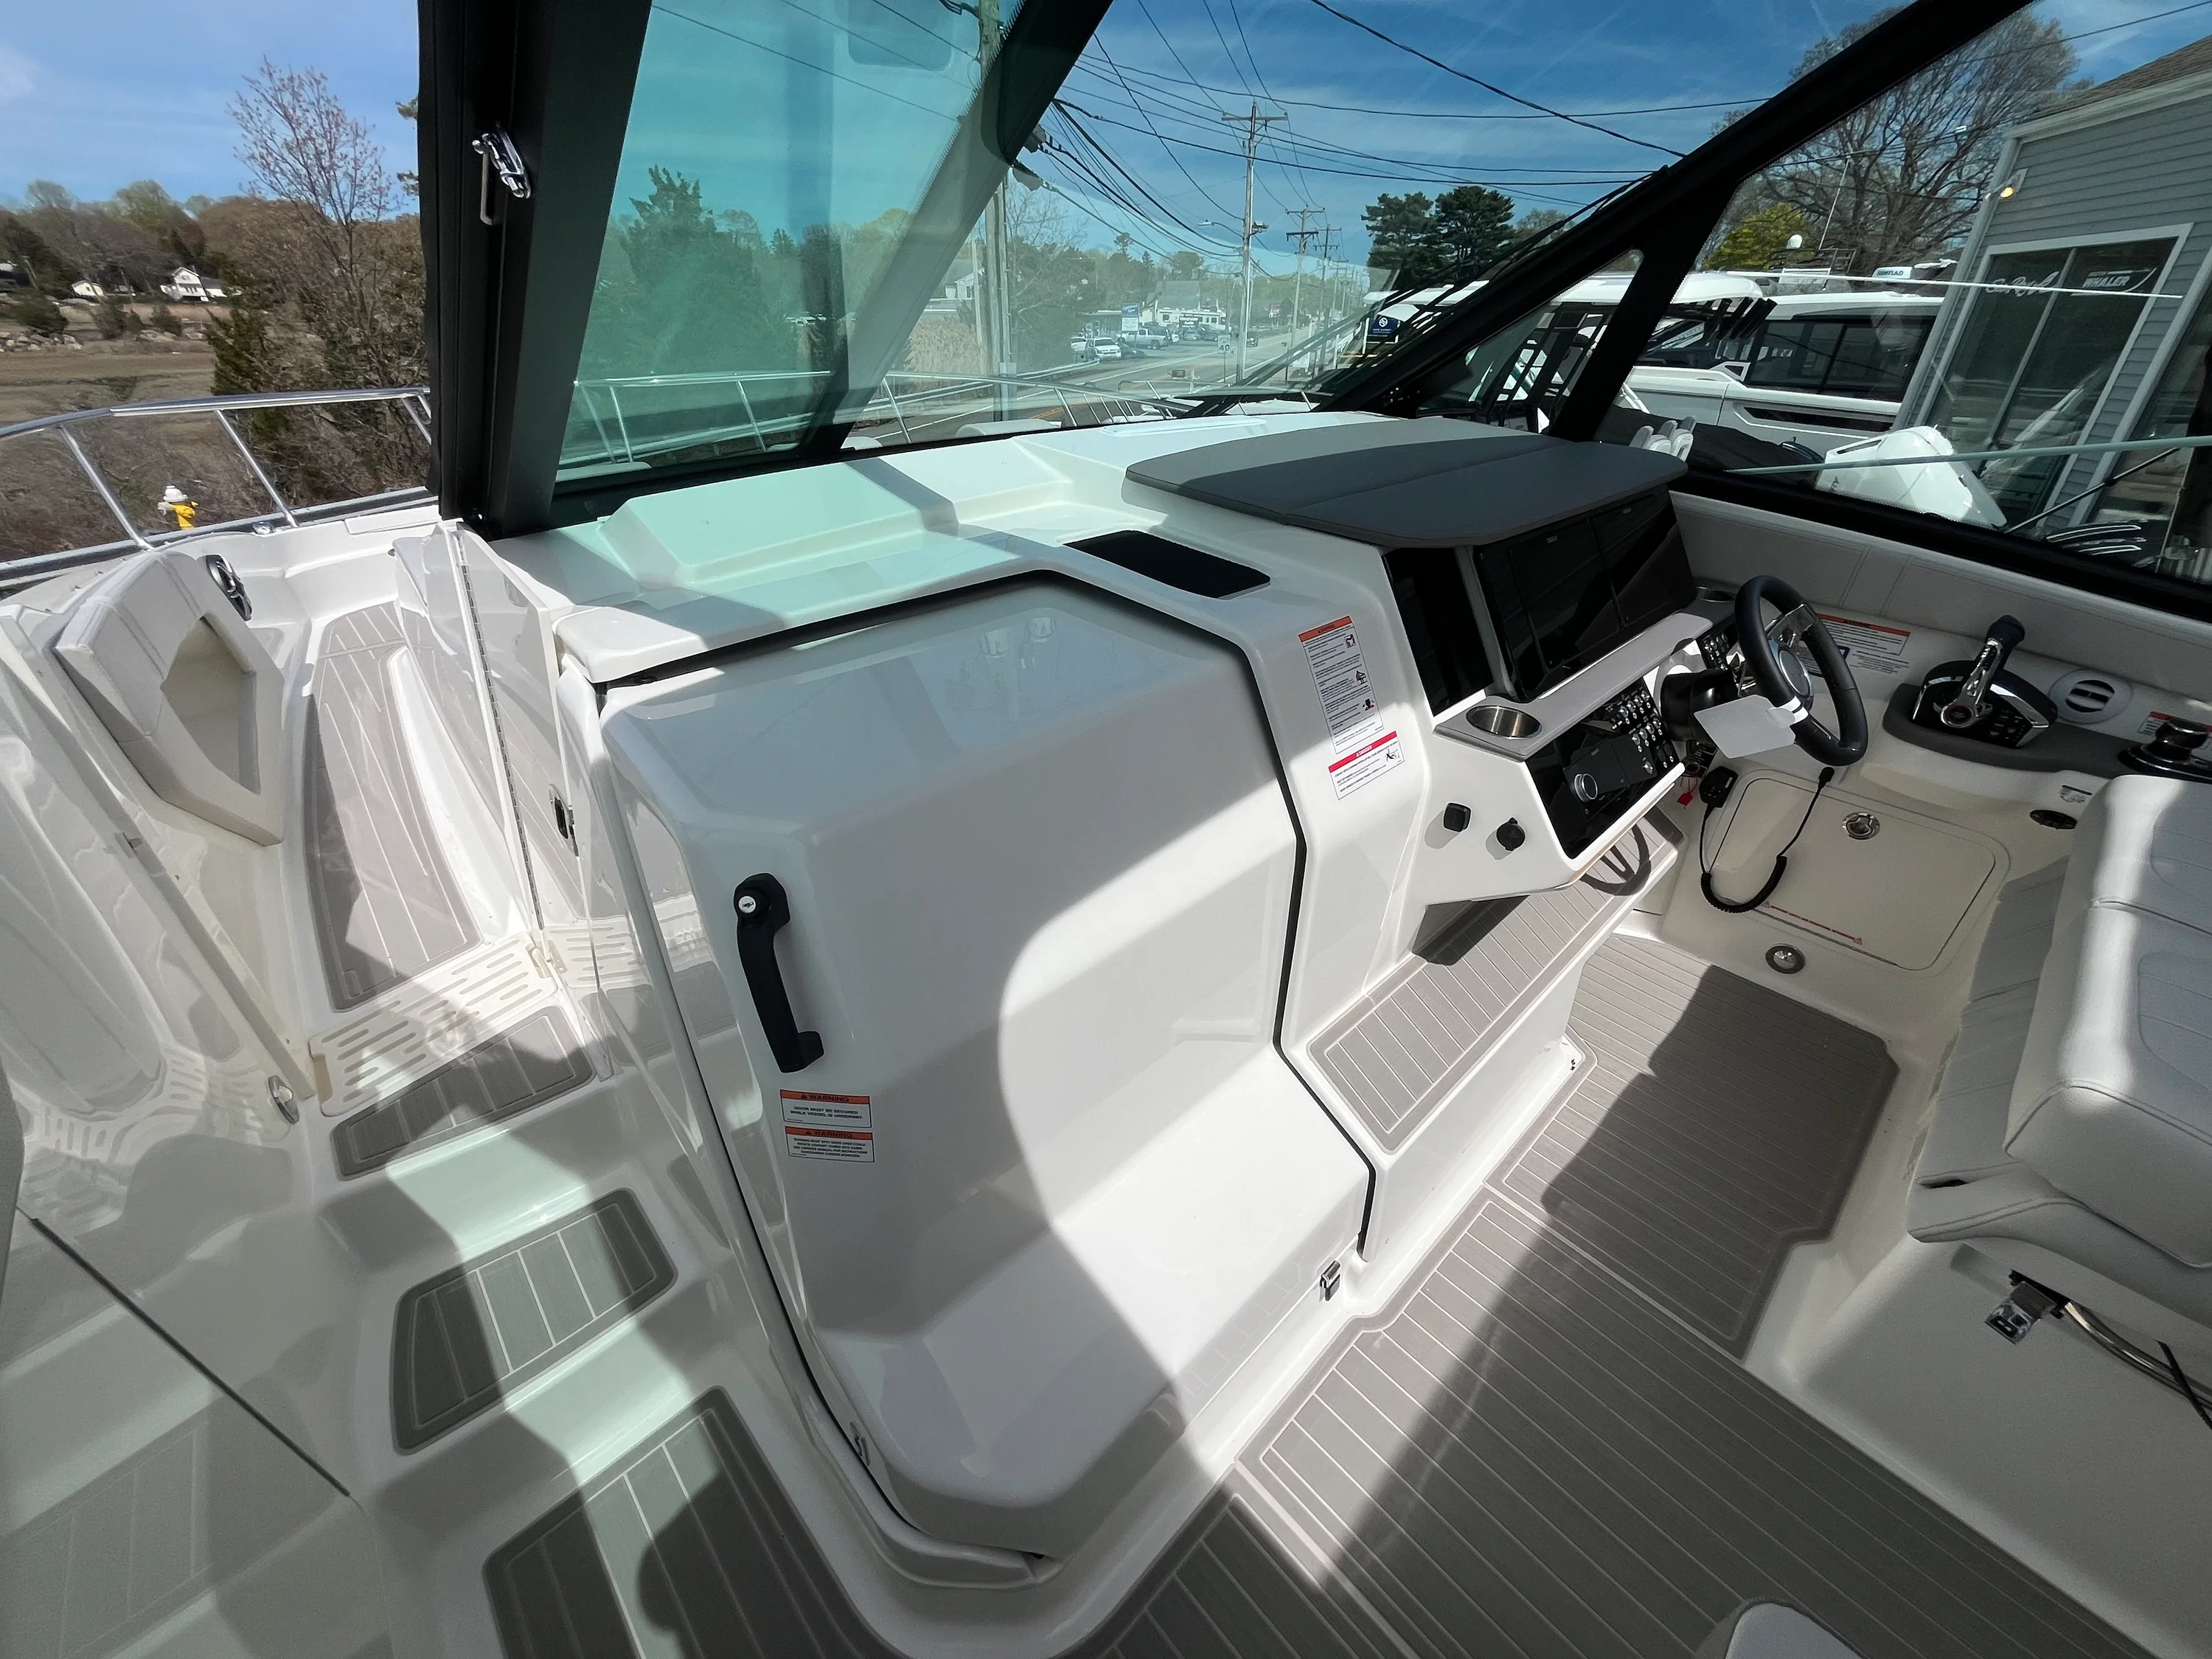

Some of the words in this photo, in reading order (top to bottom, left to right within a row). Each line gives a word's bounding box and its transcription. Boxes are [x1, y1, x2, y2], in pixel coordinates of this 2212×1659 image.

[2081, 276, 2130, 288] WHALER
[809, 1094, 849, 1102] WARNING
[813, 1130, 853, 1138] WARNING
